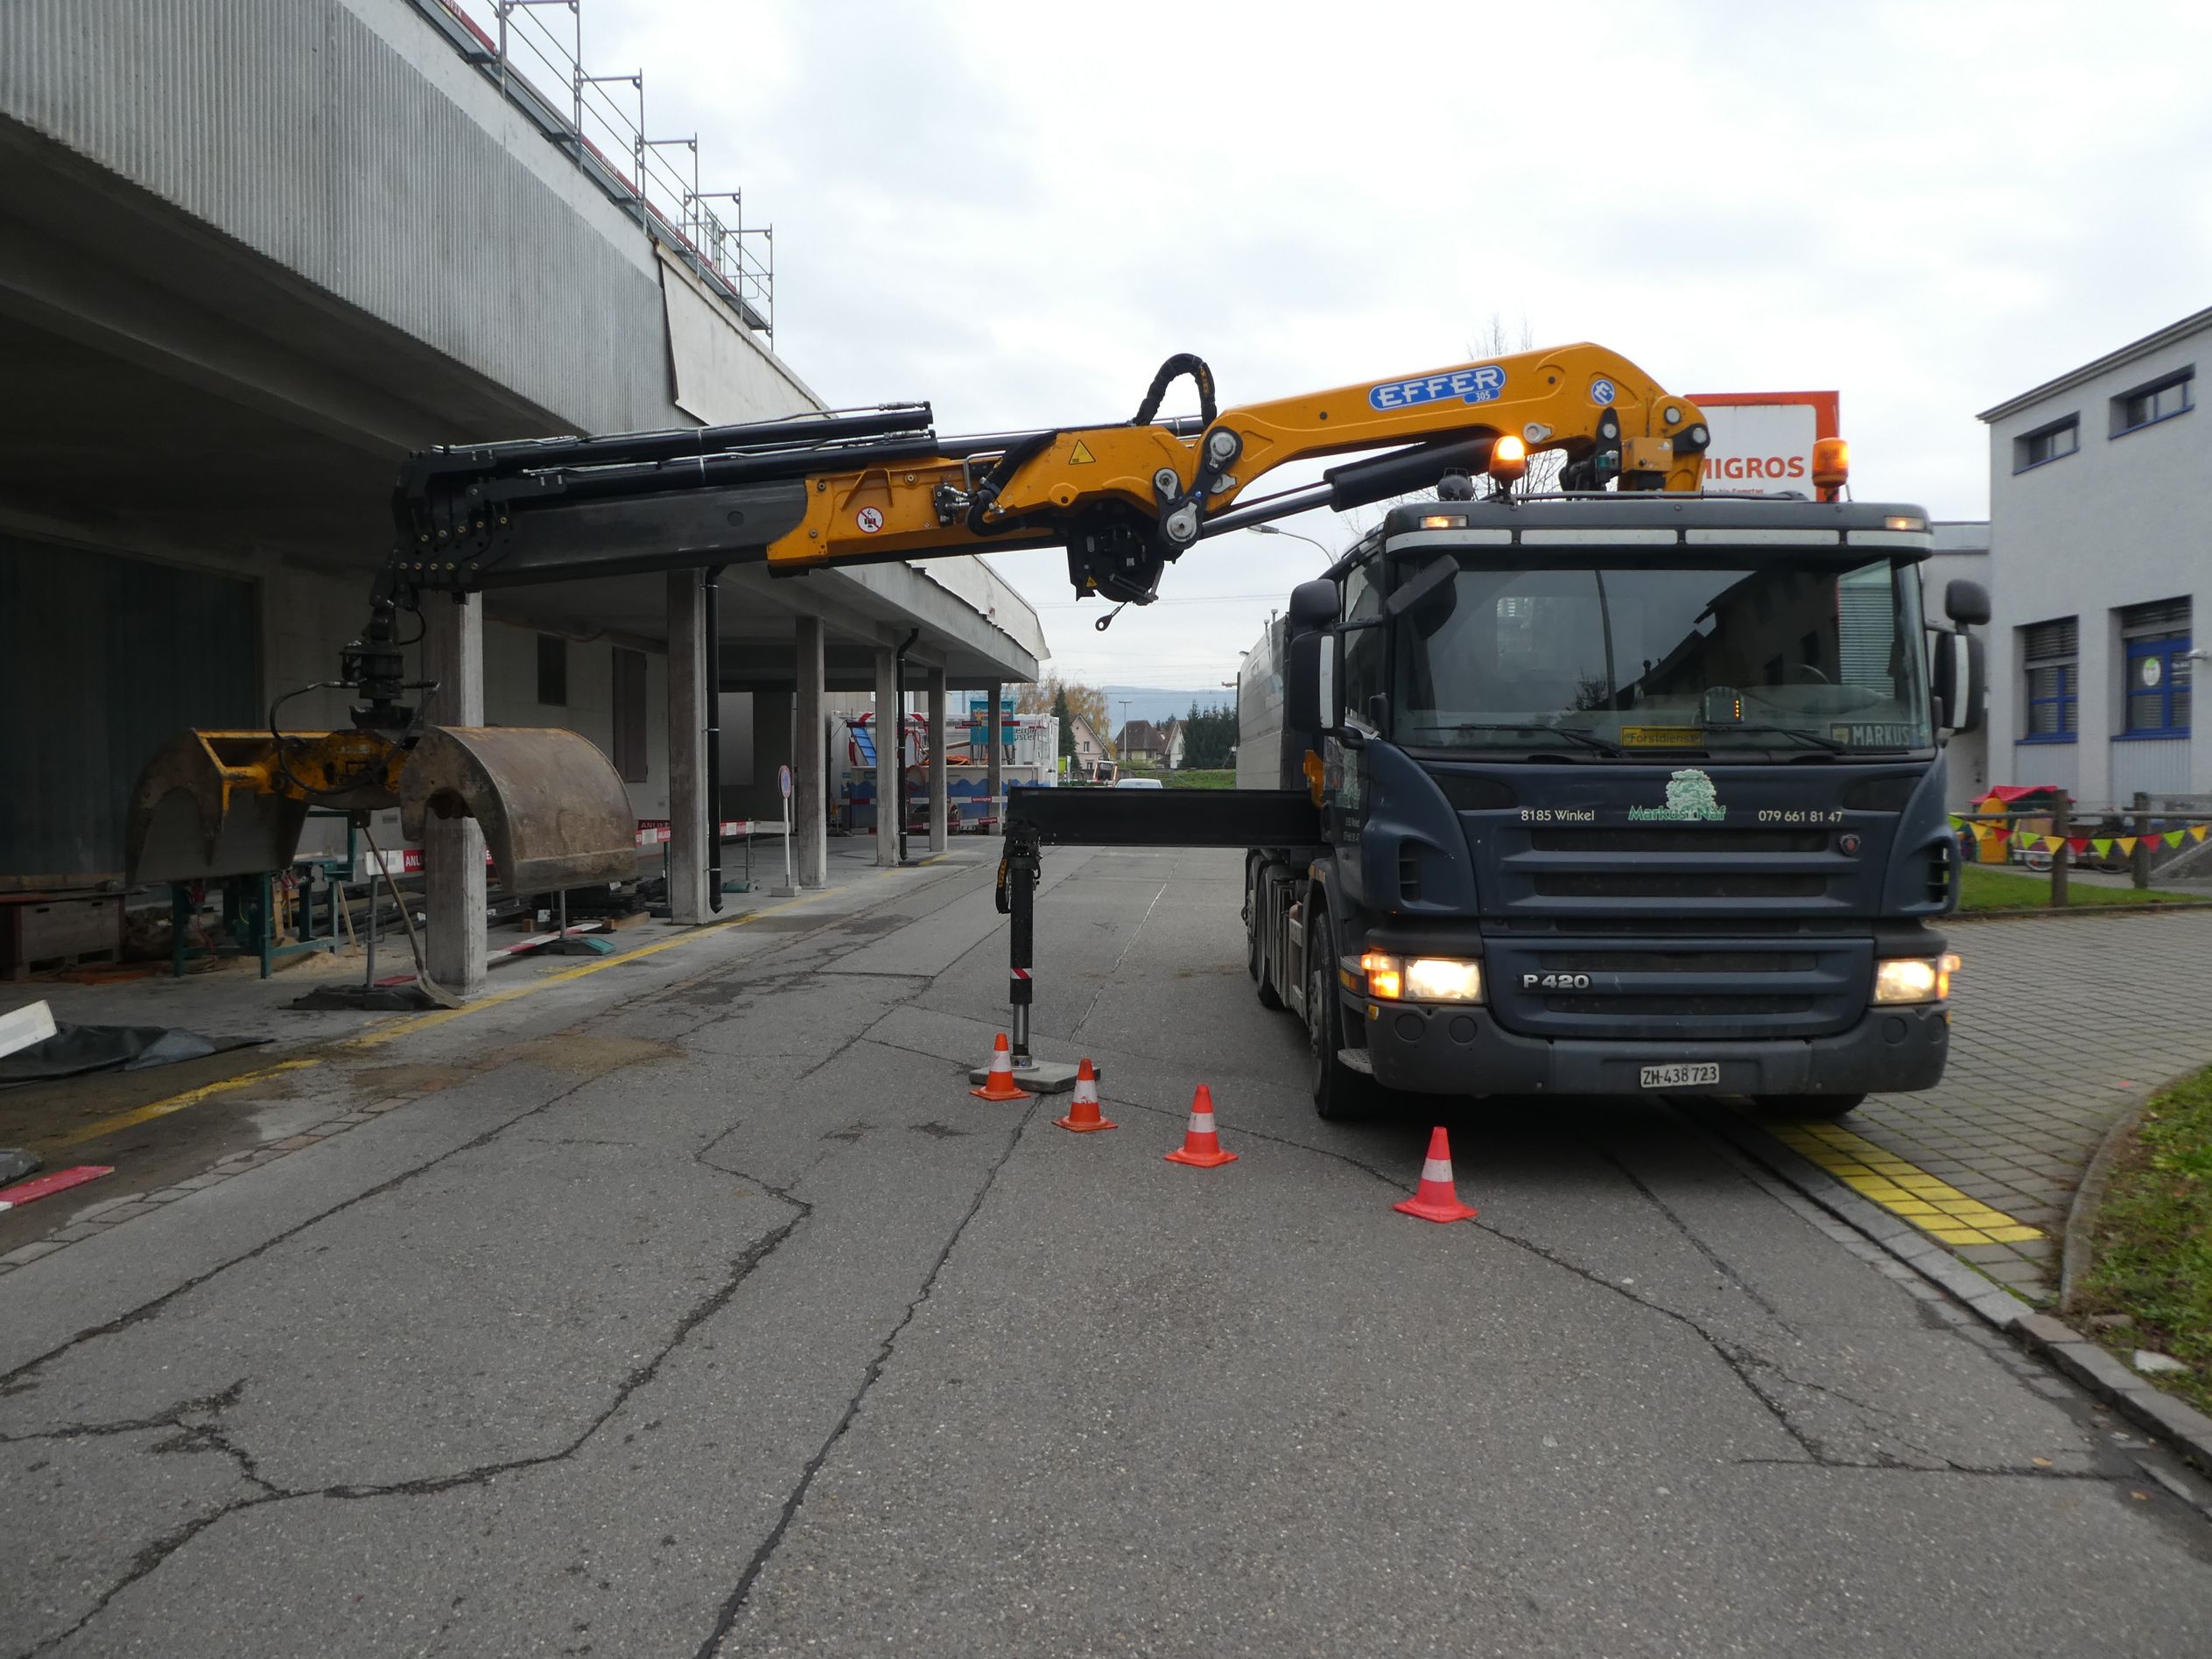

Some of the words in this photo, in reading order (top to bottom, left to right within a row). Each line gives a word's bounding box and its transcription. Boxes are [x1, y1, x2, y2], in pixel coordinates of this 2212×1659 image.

[1378, 368, 1499, 407] EFFER
[1475, 391, 1491, 402] 305
[1852, 725, 1910, 746] MARKUS
[1520, 810, 1551, 821] 8185
[1555, 810, 1595, 821] Winkel
[1628, 805, 1689, 821] Markus
[1758, 811, 1781, 822] 079
[1784, 811, 1806, 822] 661
[1808, 811, 1823, 822] 81
[1828, 812, 1842, 823] 47
[1523, 974, 1539, 988] P
[1541, 974, 1590, 988] 420
[1692, 1066, 1717, 1082] 723
